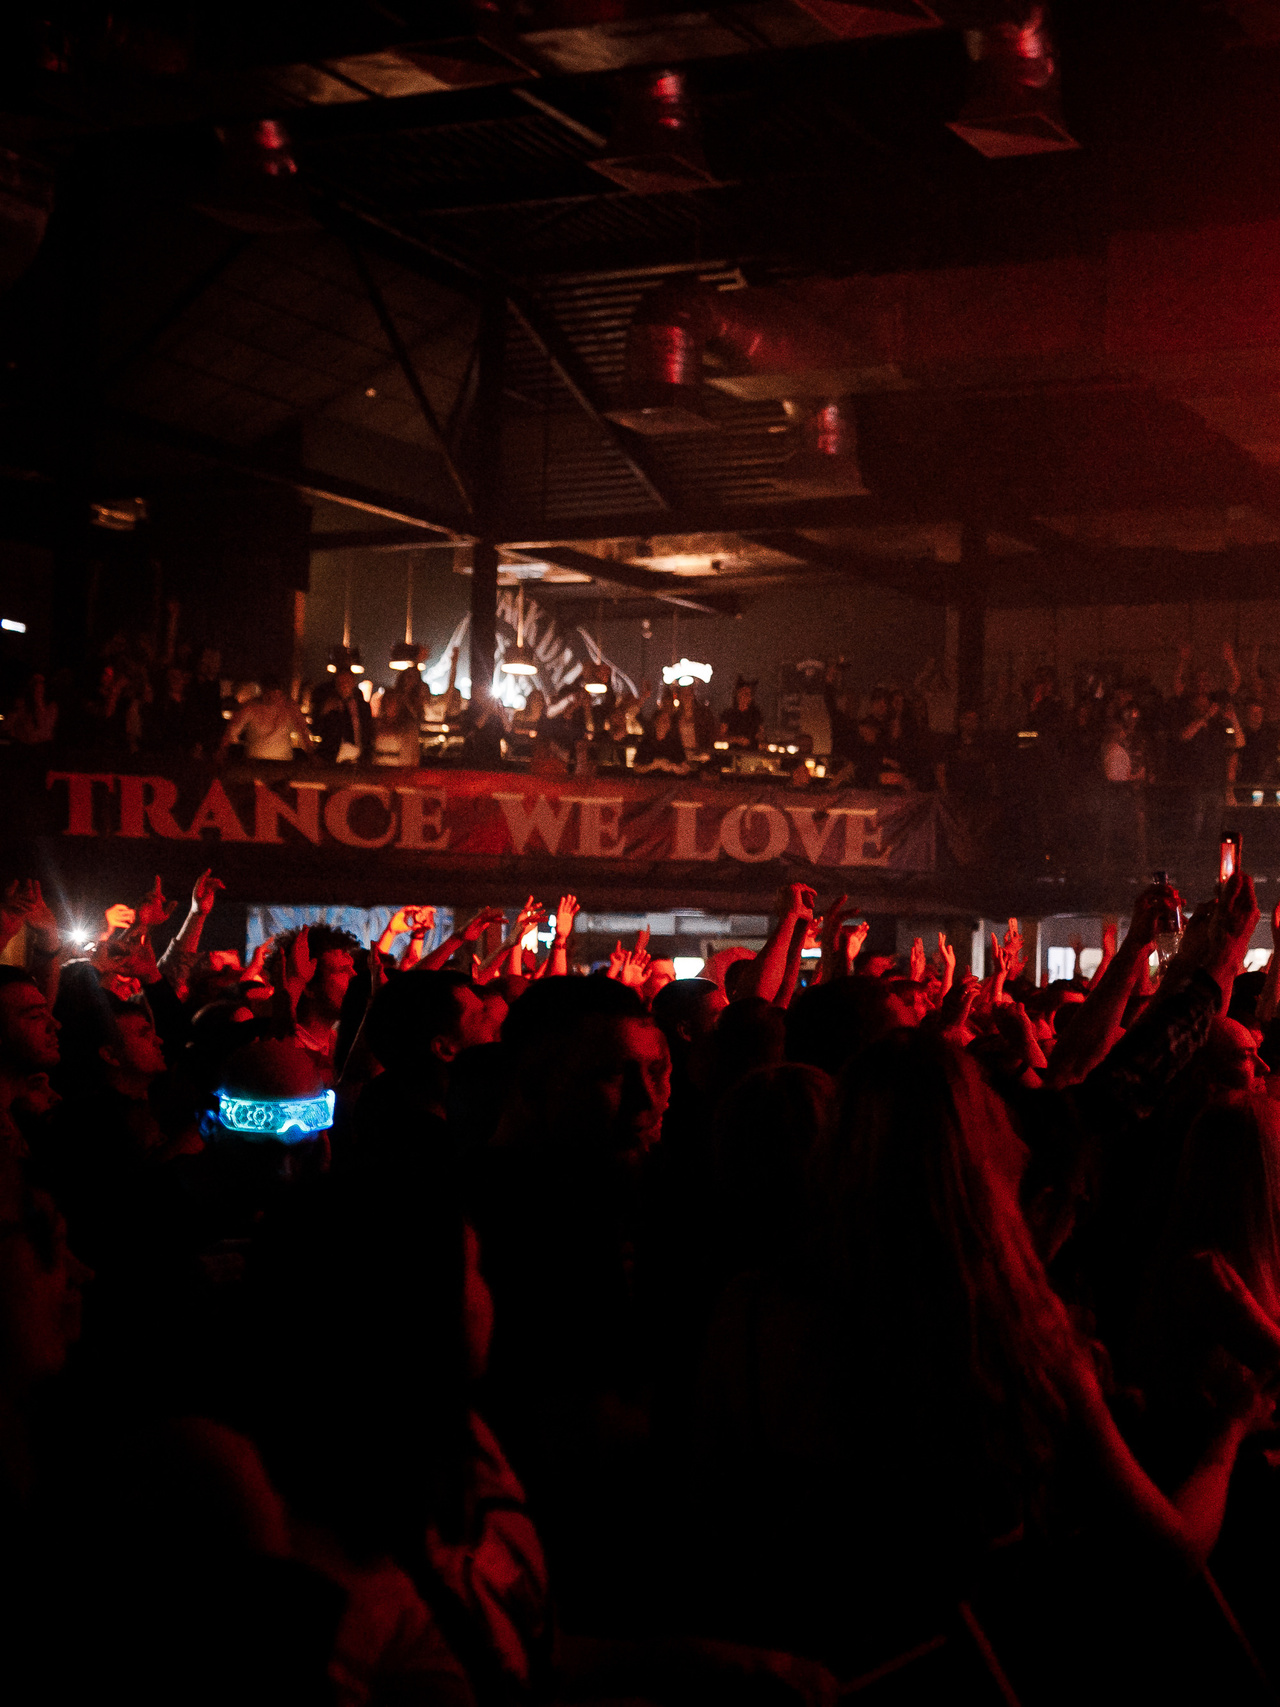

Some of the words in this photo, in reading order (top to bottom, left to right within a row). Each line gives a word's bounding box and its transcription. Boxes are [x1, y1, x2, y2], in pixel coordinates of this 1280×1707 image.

[46, 770, 452, 849] TRANCE
[492, 792, 627, 857] WE
[669, 801, 893, 867] LOVE
